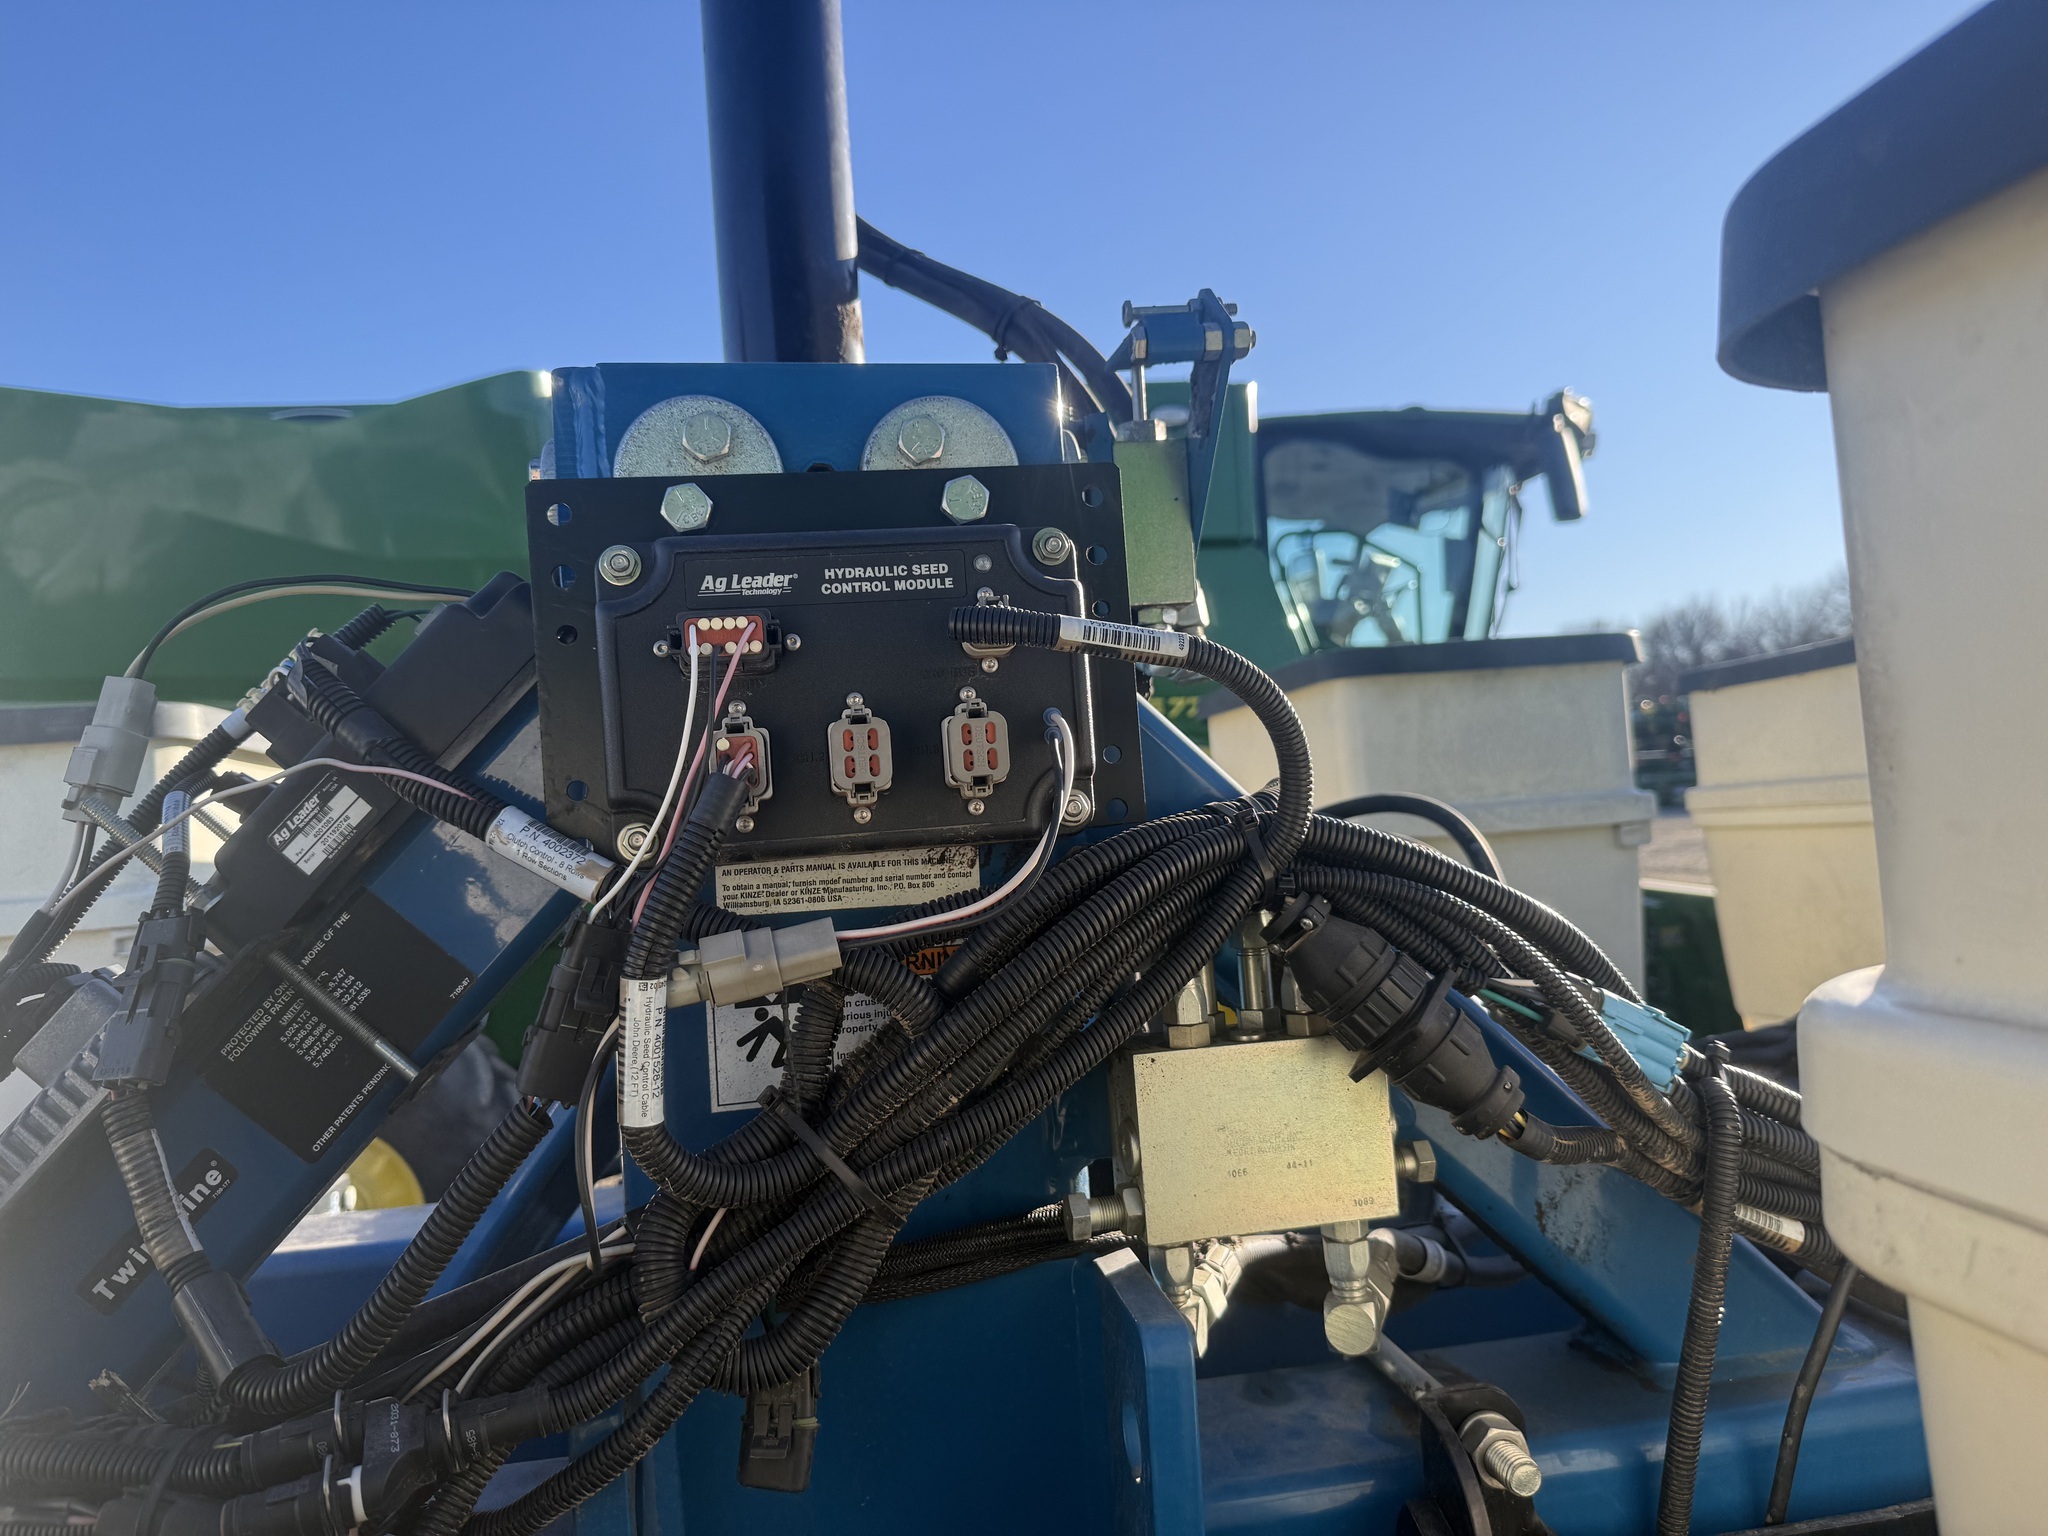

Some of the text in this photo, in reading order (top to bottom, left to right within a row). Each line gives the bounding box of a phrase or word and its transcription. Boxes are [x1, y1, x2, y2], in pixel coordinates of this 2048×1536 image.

[700, 574, 727, 593] Ag
[821, 578, 954, 595] CONTROL MODULE
[824, 563, 949, 579] HYDRAULIC SEED
[741, 587, 782, 596] Technology
[856, 732, 867, 774] DEUTSCH
[974, 726, 986, 768] DEUTSCH
[273, 794, 320, 846] Ag Leader
[507, 832, 529, 850] Clutch
[529, 845, 556, 862] Control
[558, 860, 565, 868] 8
[565, 864, 586, 880] Rows
[519, 825, 541, 843] P.N.
[542, 839, 587, 866] 4002372
[521, 852, 538, 865] Row
[539, 860, 568, 881] Sections
[721, 869, 732, 877] AN
[734, 866, 772, 876] OPERATOR
[773, 866, 779, 874] &
[781, 865, 804, 874] PARTS
[805, 863, 837, 872] MANUAL
[838, 862, 846, 870] IS
[847, 860, 886, 870] AVAILABLE
[887, 859, 901, 867] FOR
[903, 858, 919, 866] THIS
[722, 884, 730, 892] To
[732, 882, 754, 891] obtain
[792, 879, 817, 888] furnish
[818, 877, 841, 886] model
[842, 875, 869, 884] number
[870, 874, 883, 883] and
[884, 873, 904, 882] serial
[905, 872, 931, 881] number
[933, 871, 946, 880] and
[947, 870, 972, 879] contact
[722, 893, 739, 902] your
[765, 889, 789, 898] Dealer
[907, 881, 921, 889] Box
[921, 880, 935, 888] 806
[773, 898, 781, 906] IA
[827, 894, 843, 902] USA
[220, 1007, 265, 1056] PROTECTED
[262, 995, 275, 1009] BY
[301, 939, 326, 966] MORE
[322, 927, 335, 941] OF
[333, 911, 351, 929] THE
[280, 1009, 311, 1043] 5,024,173
[288, 1015, 319, 1049] 5,346,019
[632, 1017, 641, 1038] John
[842, 1011, 872, 1021] erious
[227, 1014, 273, 1062] FOLLOWING
[296, 1022, 327, 1056] 5,488,996
[304, 1028, 335, 1062] 5,647,440
[312, 1035, 343, 1069] 5,740,870
[641, 996, 654, 1118] Hydraulic Seed Control Cable
[652, 1033, 662, 1099] 4001528-12
[629, 1082, 639, 1098] FT)
[312, 1125, 337, 1152] OTHER
[334, 1093, 364, 1127] PATENTS
[390, 1402, 400, 1453] 2031-873
